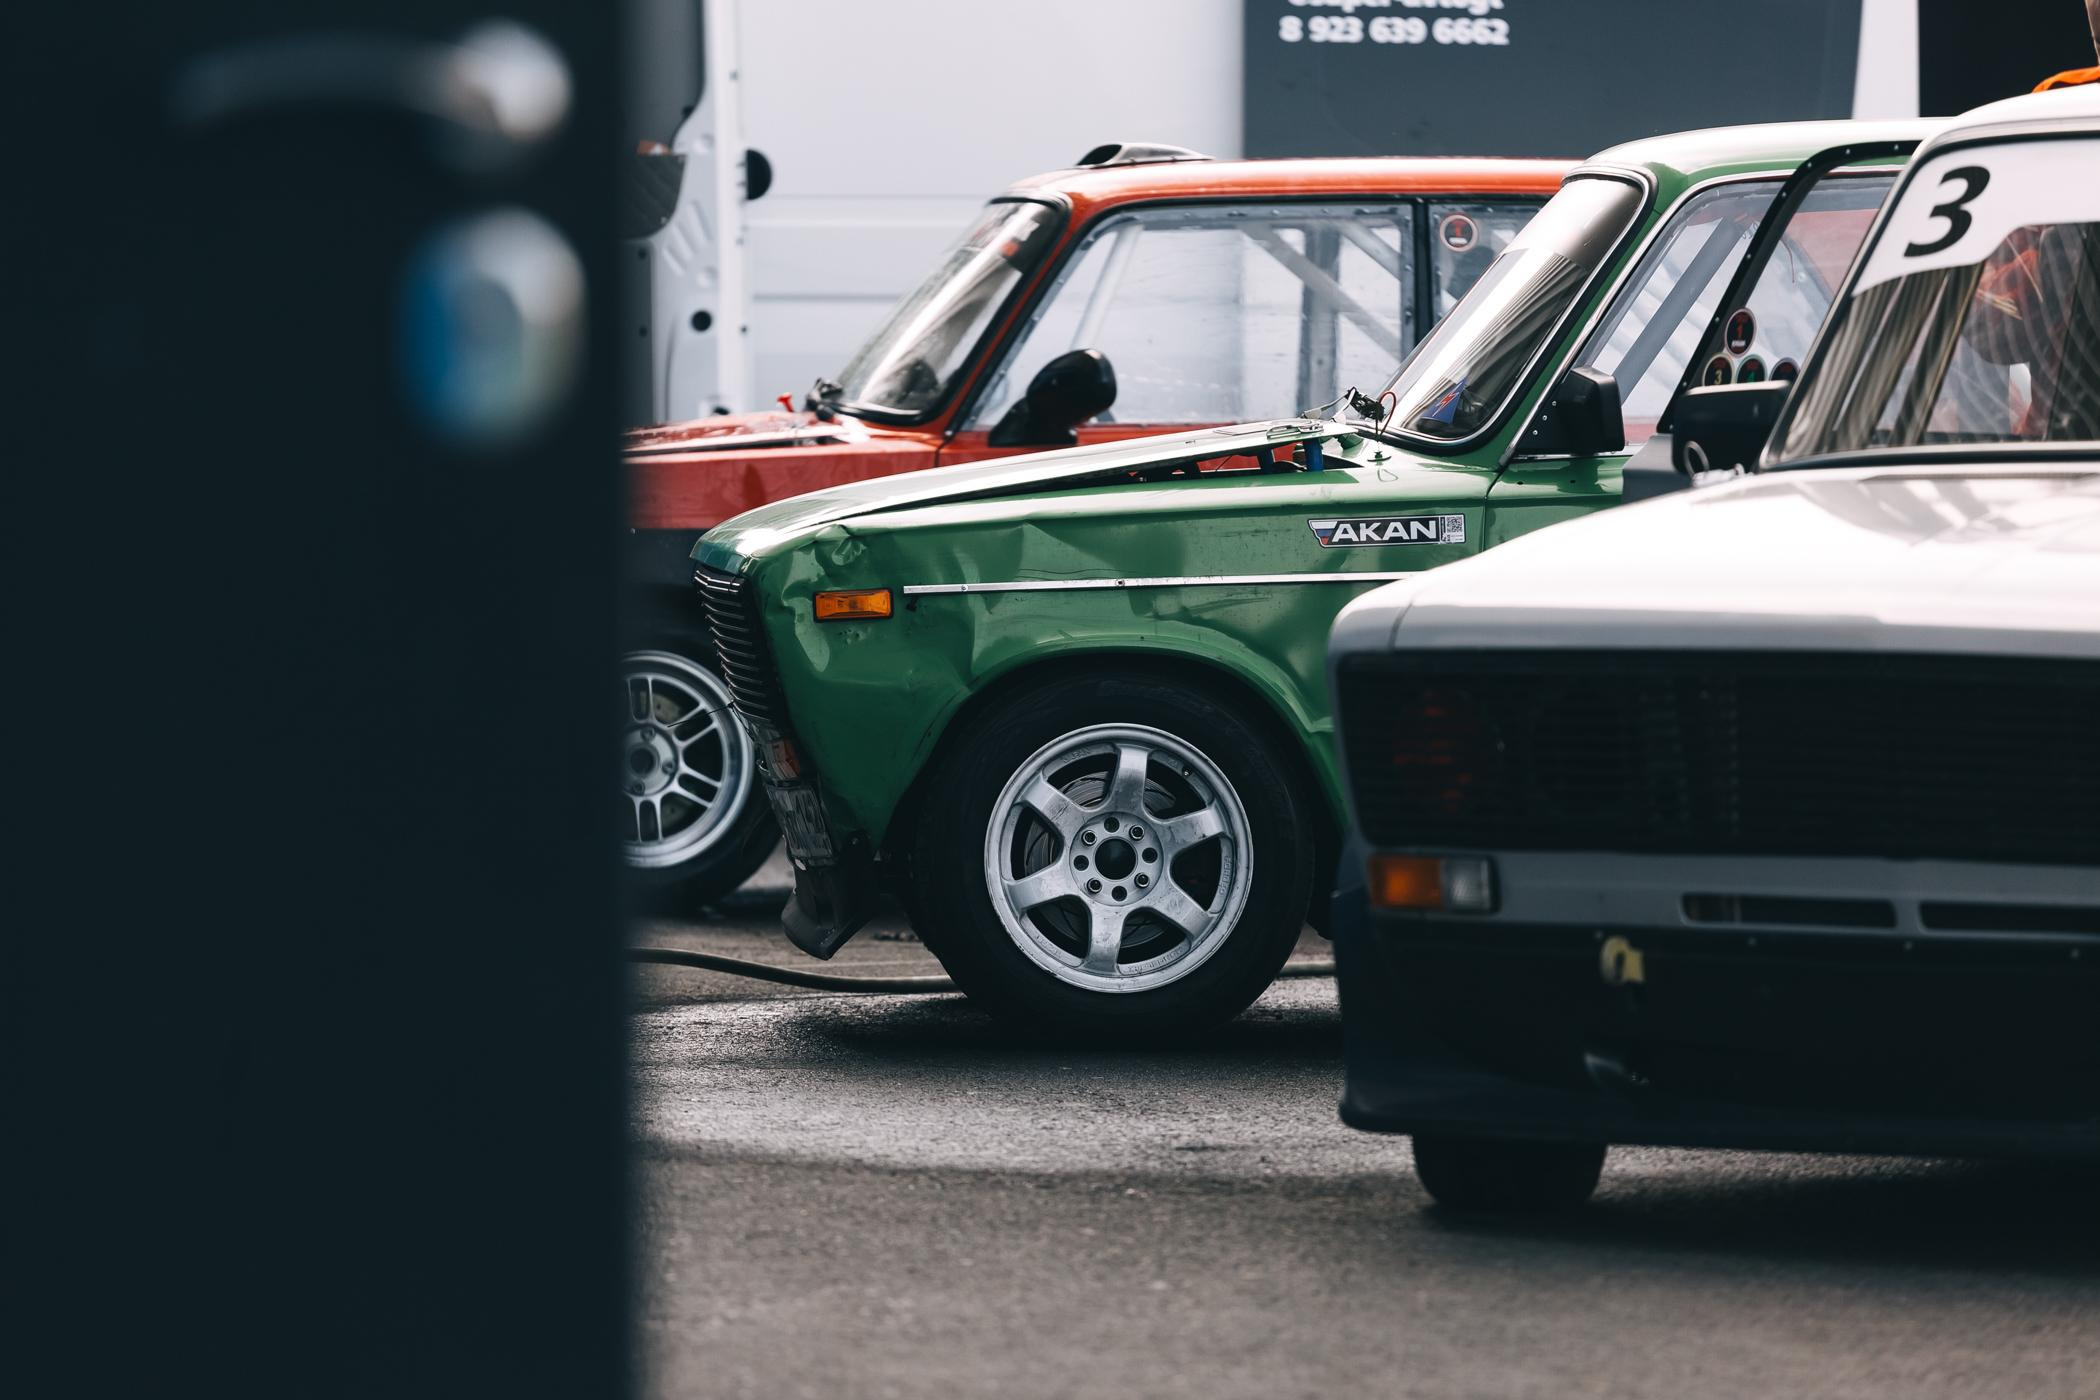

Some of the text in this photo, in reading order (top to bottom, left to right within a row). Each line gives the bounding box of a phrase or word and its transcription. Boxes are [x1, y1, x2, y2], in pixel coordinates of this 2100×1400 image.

[1278, 15, 1511, 46] 8 923 639 6662
[1903, 166, 1990, 257] 3
[1332, 520, 1437, 543] AKAN
